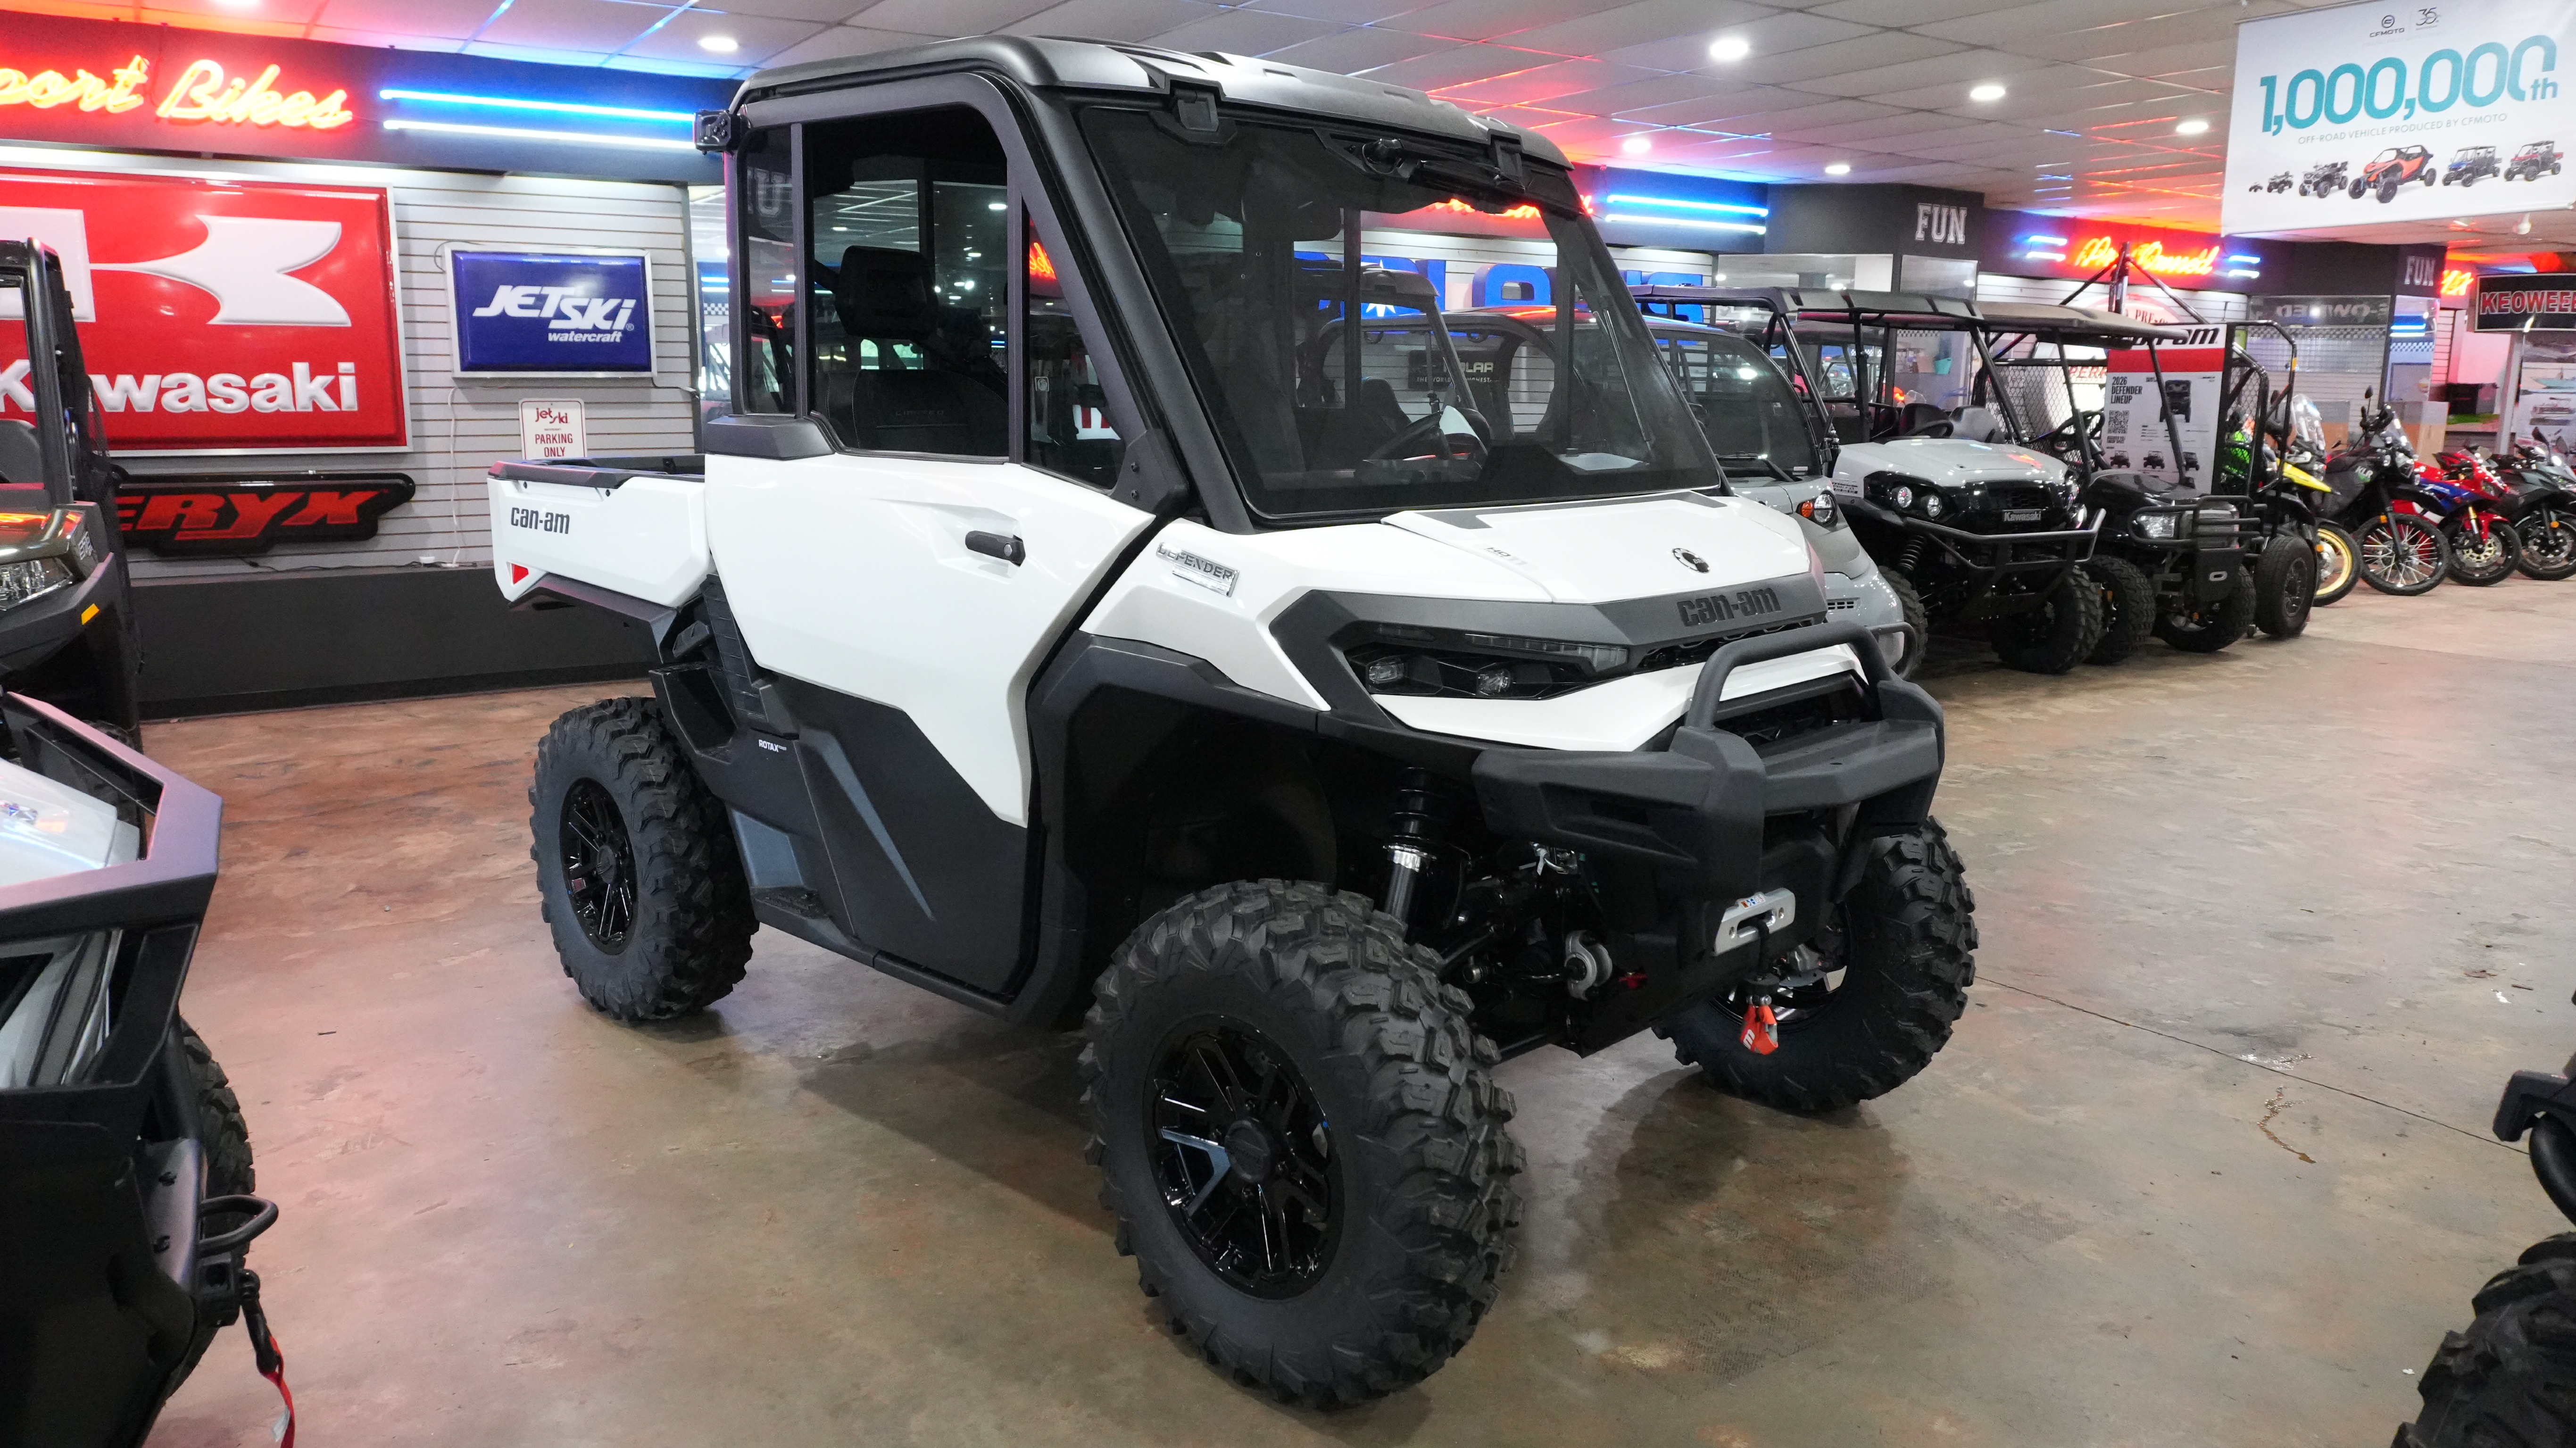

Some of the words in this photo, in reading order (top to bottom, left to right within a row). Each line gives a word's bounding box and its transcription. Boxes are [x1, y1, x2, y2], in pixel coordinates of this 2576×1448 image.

[2369, 27, 2405, 38] CFMOTO
[0, 55, 150, 114] port
[156, 59, 353, 130] Bikes
[2298, 132, 2346, 145] OFF-ROAD
[2348, 127, 2387, 139] VEHICLE
[2388, 120, 2443, 133] PRODUCED
[2446, 118, 2459, 128] BY
[2461, 113, 2508, 126] CFMOTO
[1915, 202, 1968, 245] FUN
[2404, 256, 2436, 287] FUN
[548, 331, 623, 343] watercraft
[0, 359, 358, 414] Kwasaki
[2112, 376, 2127, 385] 2026
[2111, 386, 2143, 394] DEFENDER
[2111, 395, 2133, 404] LINEUP
[535, 408, 553, 422] jet
[549, 412, 568, 424] ski
[535, 433, 573, 444] PARKING
[544, 446, 565, 458] ONLY
[2354, 466, 2374, 479] KLR
[115, 491, 380, 541] ERYX
[510, 507, 570, 535] can-am
[2004, 511, 2042, 522] Kawasaki
[1157, 543, 1234, 580] DEFENDER
[1677, 587, 1782, 627] can-am
[758, 739, 779, 753] ROTAX
